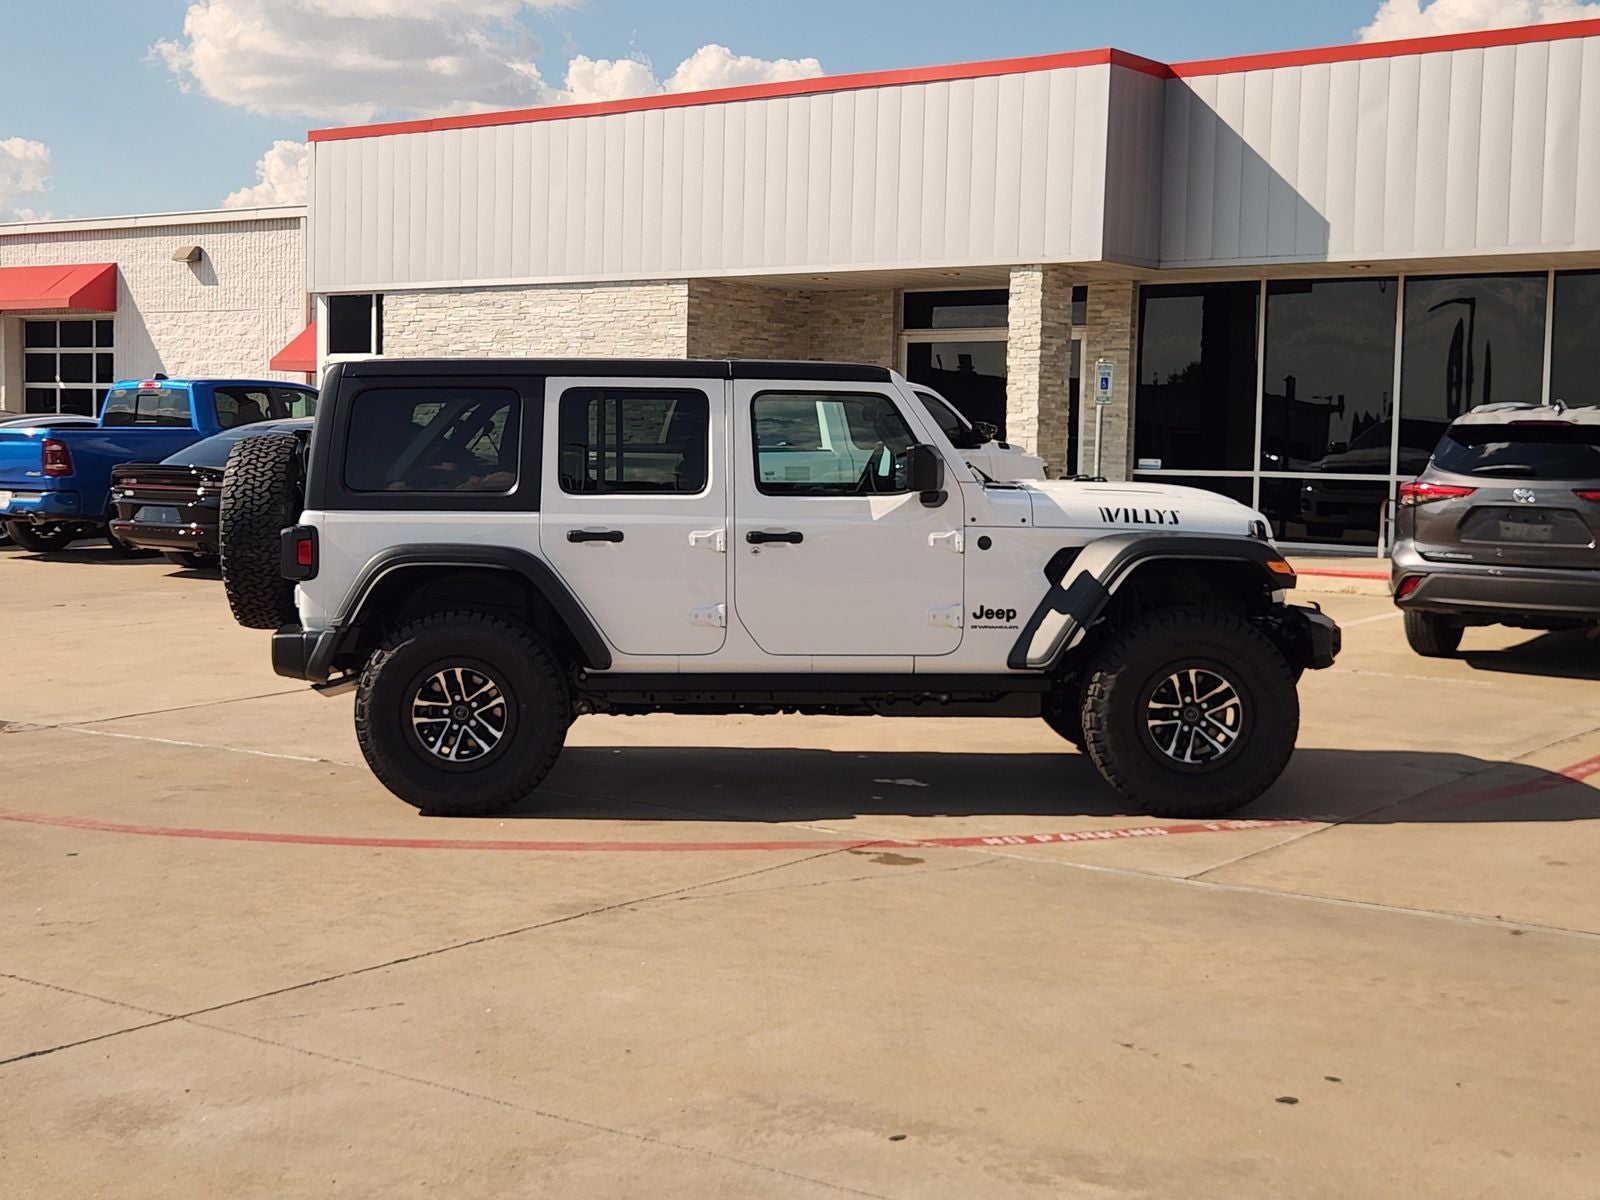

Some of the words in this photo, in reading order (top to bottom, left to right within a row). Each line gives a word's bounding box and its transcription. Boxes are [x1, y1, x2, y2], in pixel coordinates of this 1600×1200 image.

[1099, 507, 1179, 525] WILLYS
[972, 604, 1017, 622] Jeep
[981, 834, 1026, 844] NO
[1033, 826, 1169, 842] PARKING
